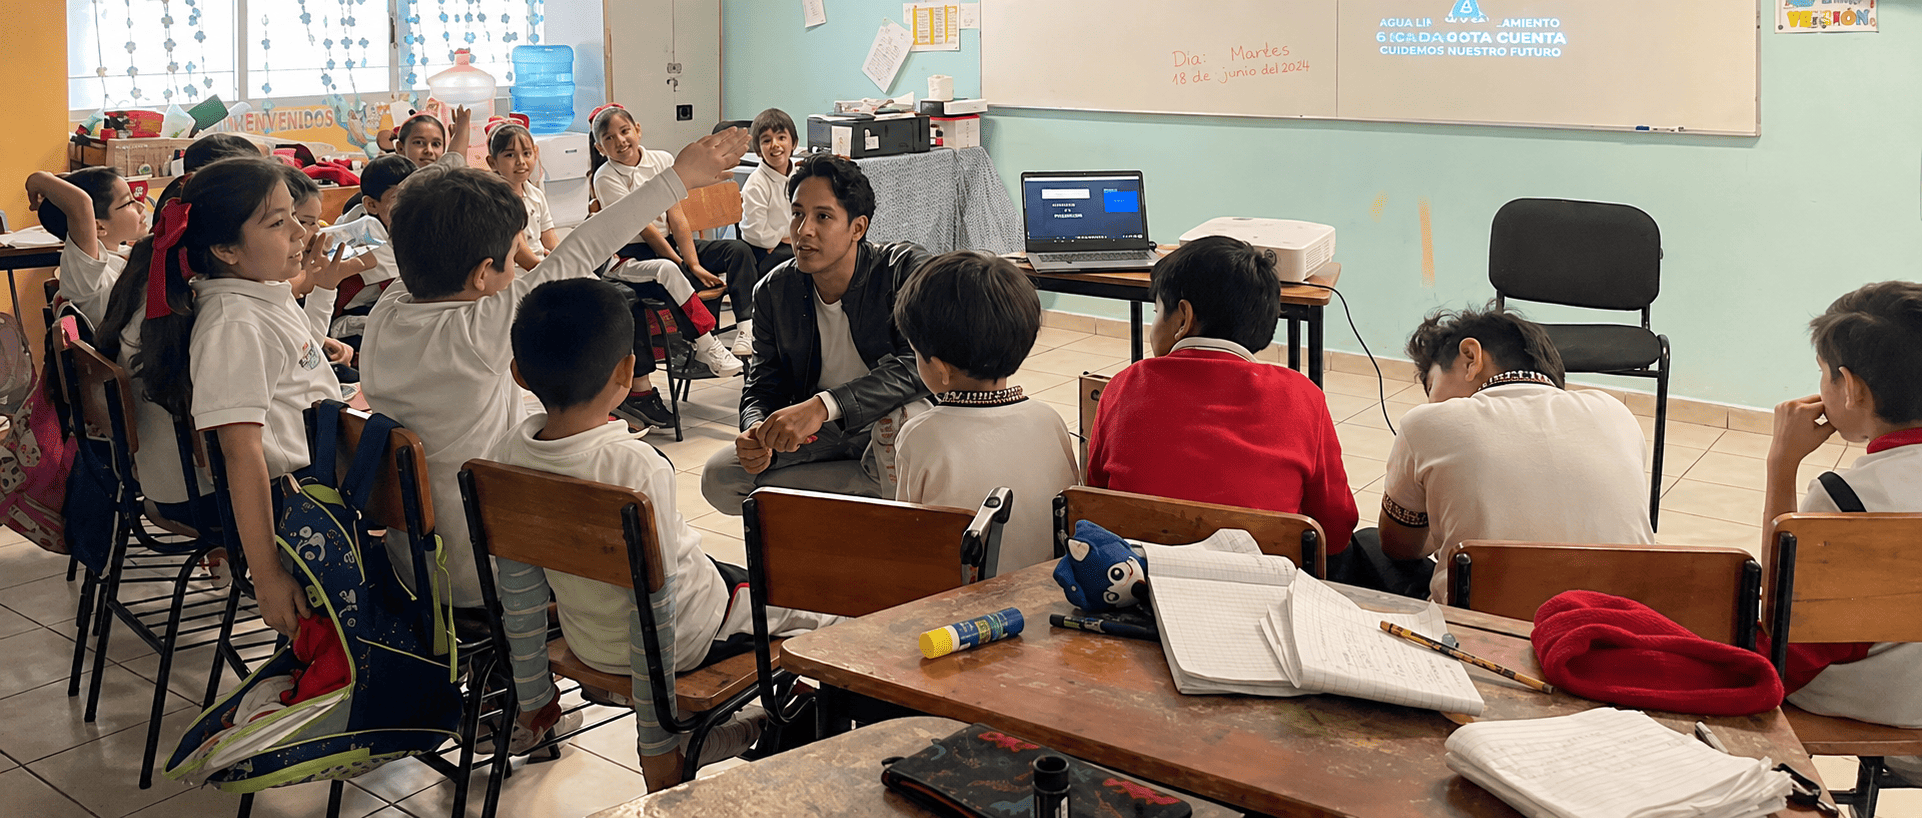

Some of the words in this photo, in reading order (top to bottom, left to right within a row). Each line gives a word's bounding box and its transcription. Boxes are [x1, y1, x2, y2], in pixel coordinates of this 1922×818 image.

[1379, 17, 1414, 28] AGUA
[1496, 18, 1561, 28] AMIENTO
[1376, 31, 1387, 43] 6
[1496, 31, 1568, 45] CUENTA
[1230, 41, 1290, 62] Martes
[1379, 45, 1445, 56] CUIDEMOS
[1447, 46, 1507, 57] NUESTRO
[1509, 47, 1562, 58] FUTURO
[1172, 71, 1187, 86] 18
[1192, 69, 1212, 84] de
[1217, 66, 1257, 85] junio
[1260, 62, 1279, 76] del
[1281, 59, 1311, 74] 2024
